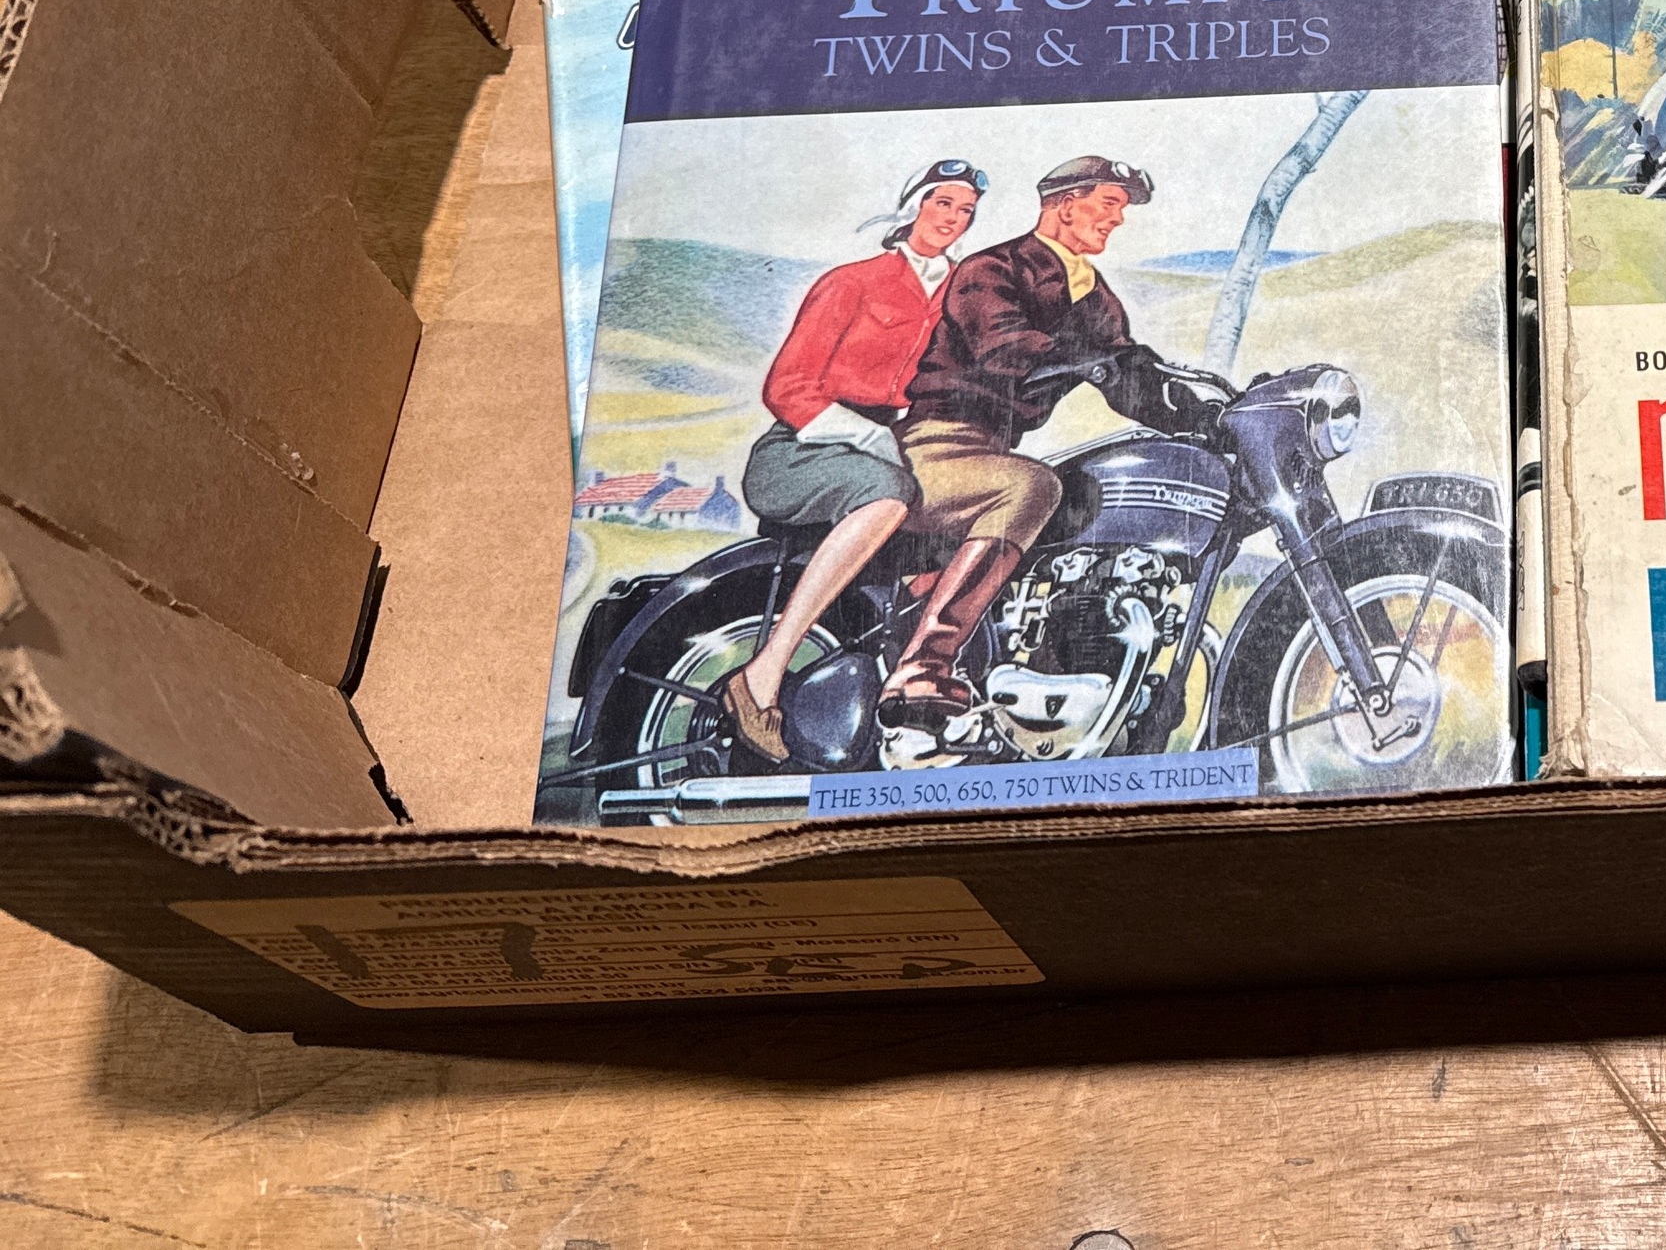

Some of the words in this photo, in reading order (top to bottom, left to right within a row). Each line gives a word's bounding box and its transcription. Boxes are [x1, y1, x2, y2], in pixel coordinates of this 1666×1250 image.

[814, 28, 1012, 79] TWINS
[1036, 28, 1077, 67] &
[1107, 18, 1331, 65] TRIPLES
[815, 788, 861, 810] THE
[869, 786, 905, 807] 350,
[913, 782, 951, 804] 500,
[958, 780, 997, 802] 650,
[1005, 777, 1040, 799] 750
[1043, 772, 1121, 796] TWINS
[1121, 770, 1145, 791] &
[1150, 764, 1253, 789] TRIDENT
